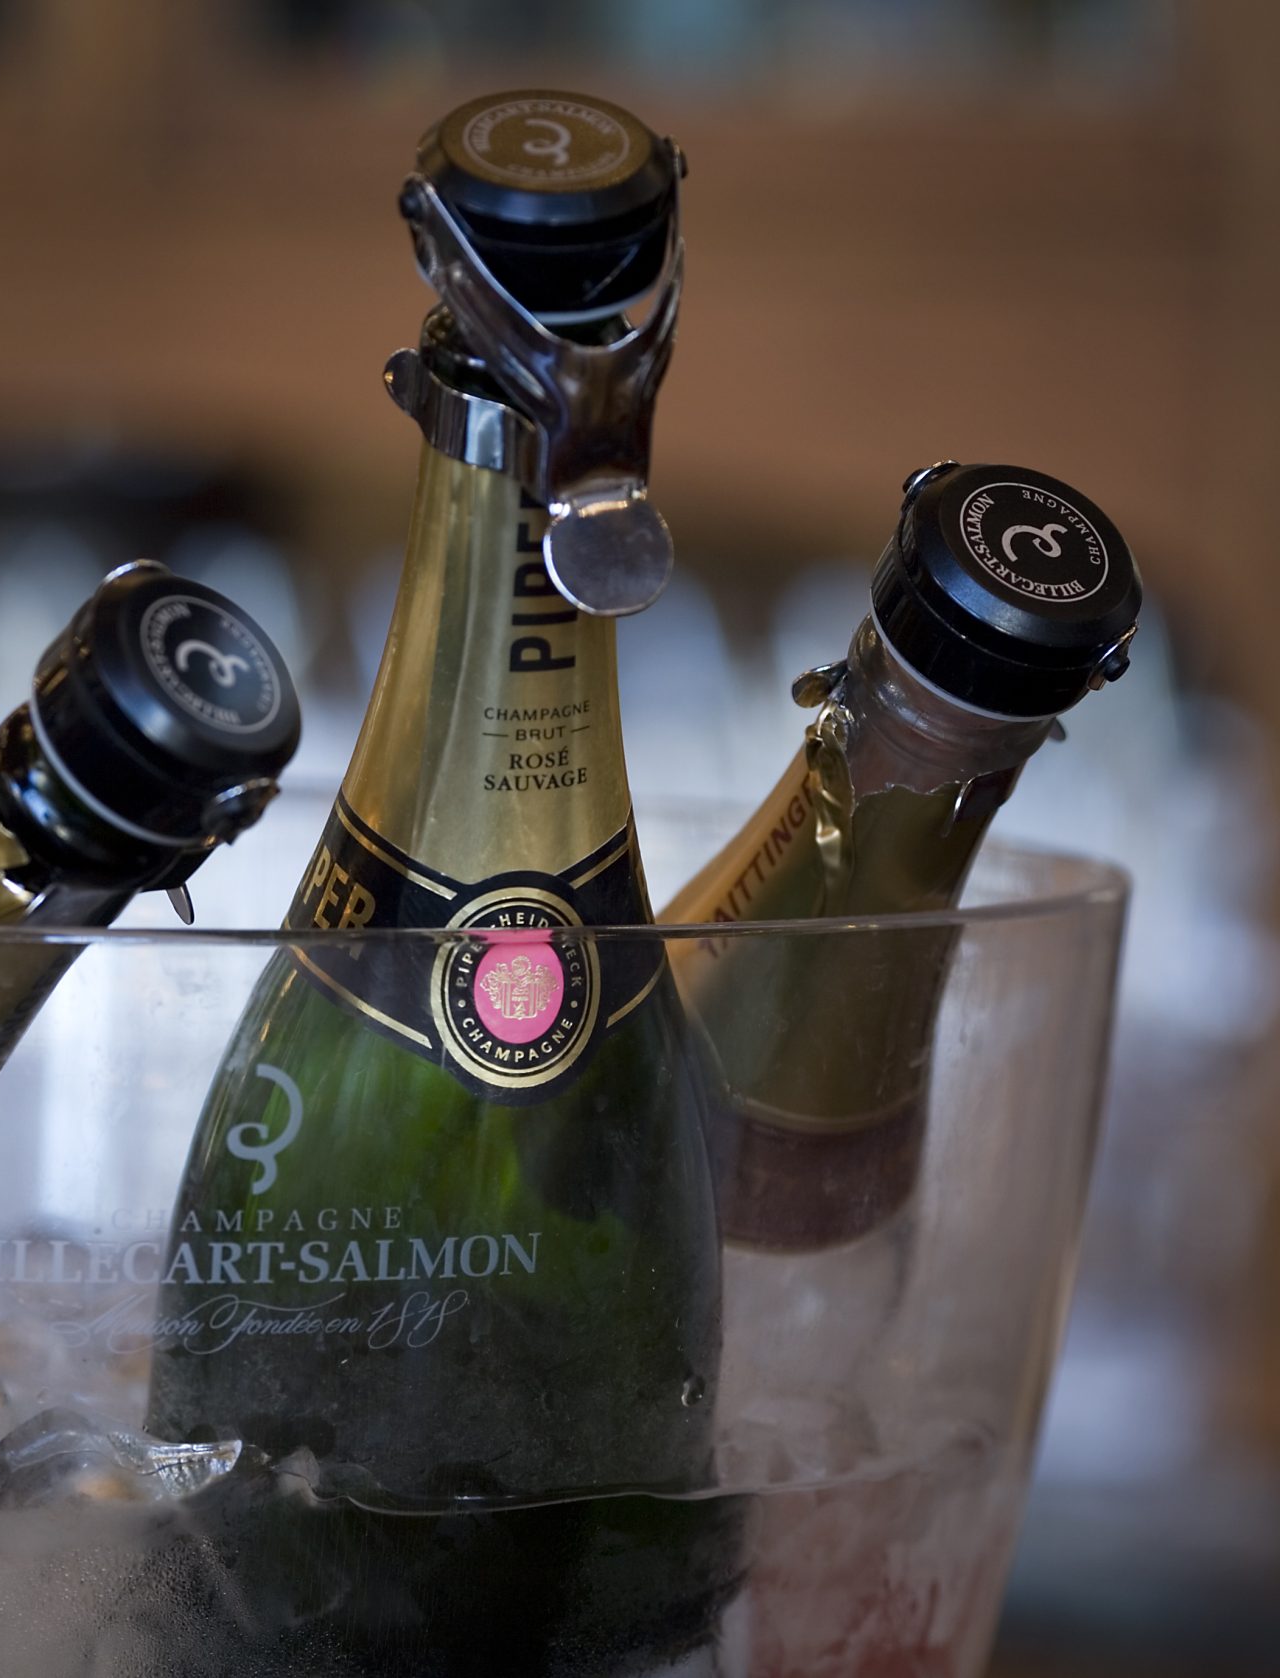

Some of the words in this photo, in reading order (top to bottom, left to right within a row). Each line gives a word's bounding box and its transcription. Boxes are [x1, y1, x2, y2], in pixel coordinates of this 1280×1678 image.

[966, 492, 1086, 597] BILLECART-SALMON
[1022, 488, 1102, 566] CHAMPAGNE
[509, 487, 578, 672] PIP
[483, 701, 590, 721] CHAMPAGNE
[515, 726, 565, 741] BRUT
[509, 746, 570, 770] ROSÉ
[483, 768, 588, 792] SAUVAGE
[462, 1017, 574, 1063] CHAMPAGNE
[110, 1205, 402, 1234] CHAMPAGNE
[324, 1318, 365, 1336] en
[366, 1289, 471, 1351] 1818
